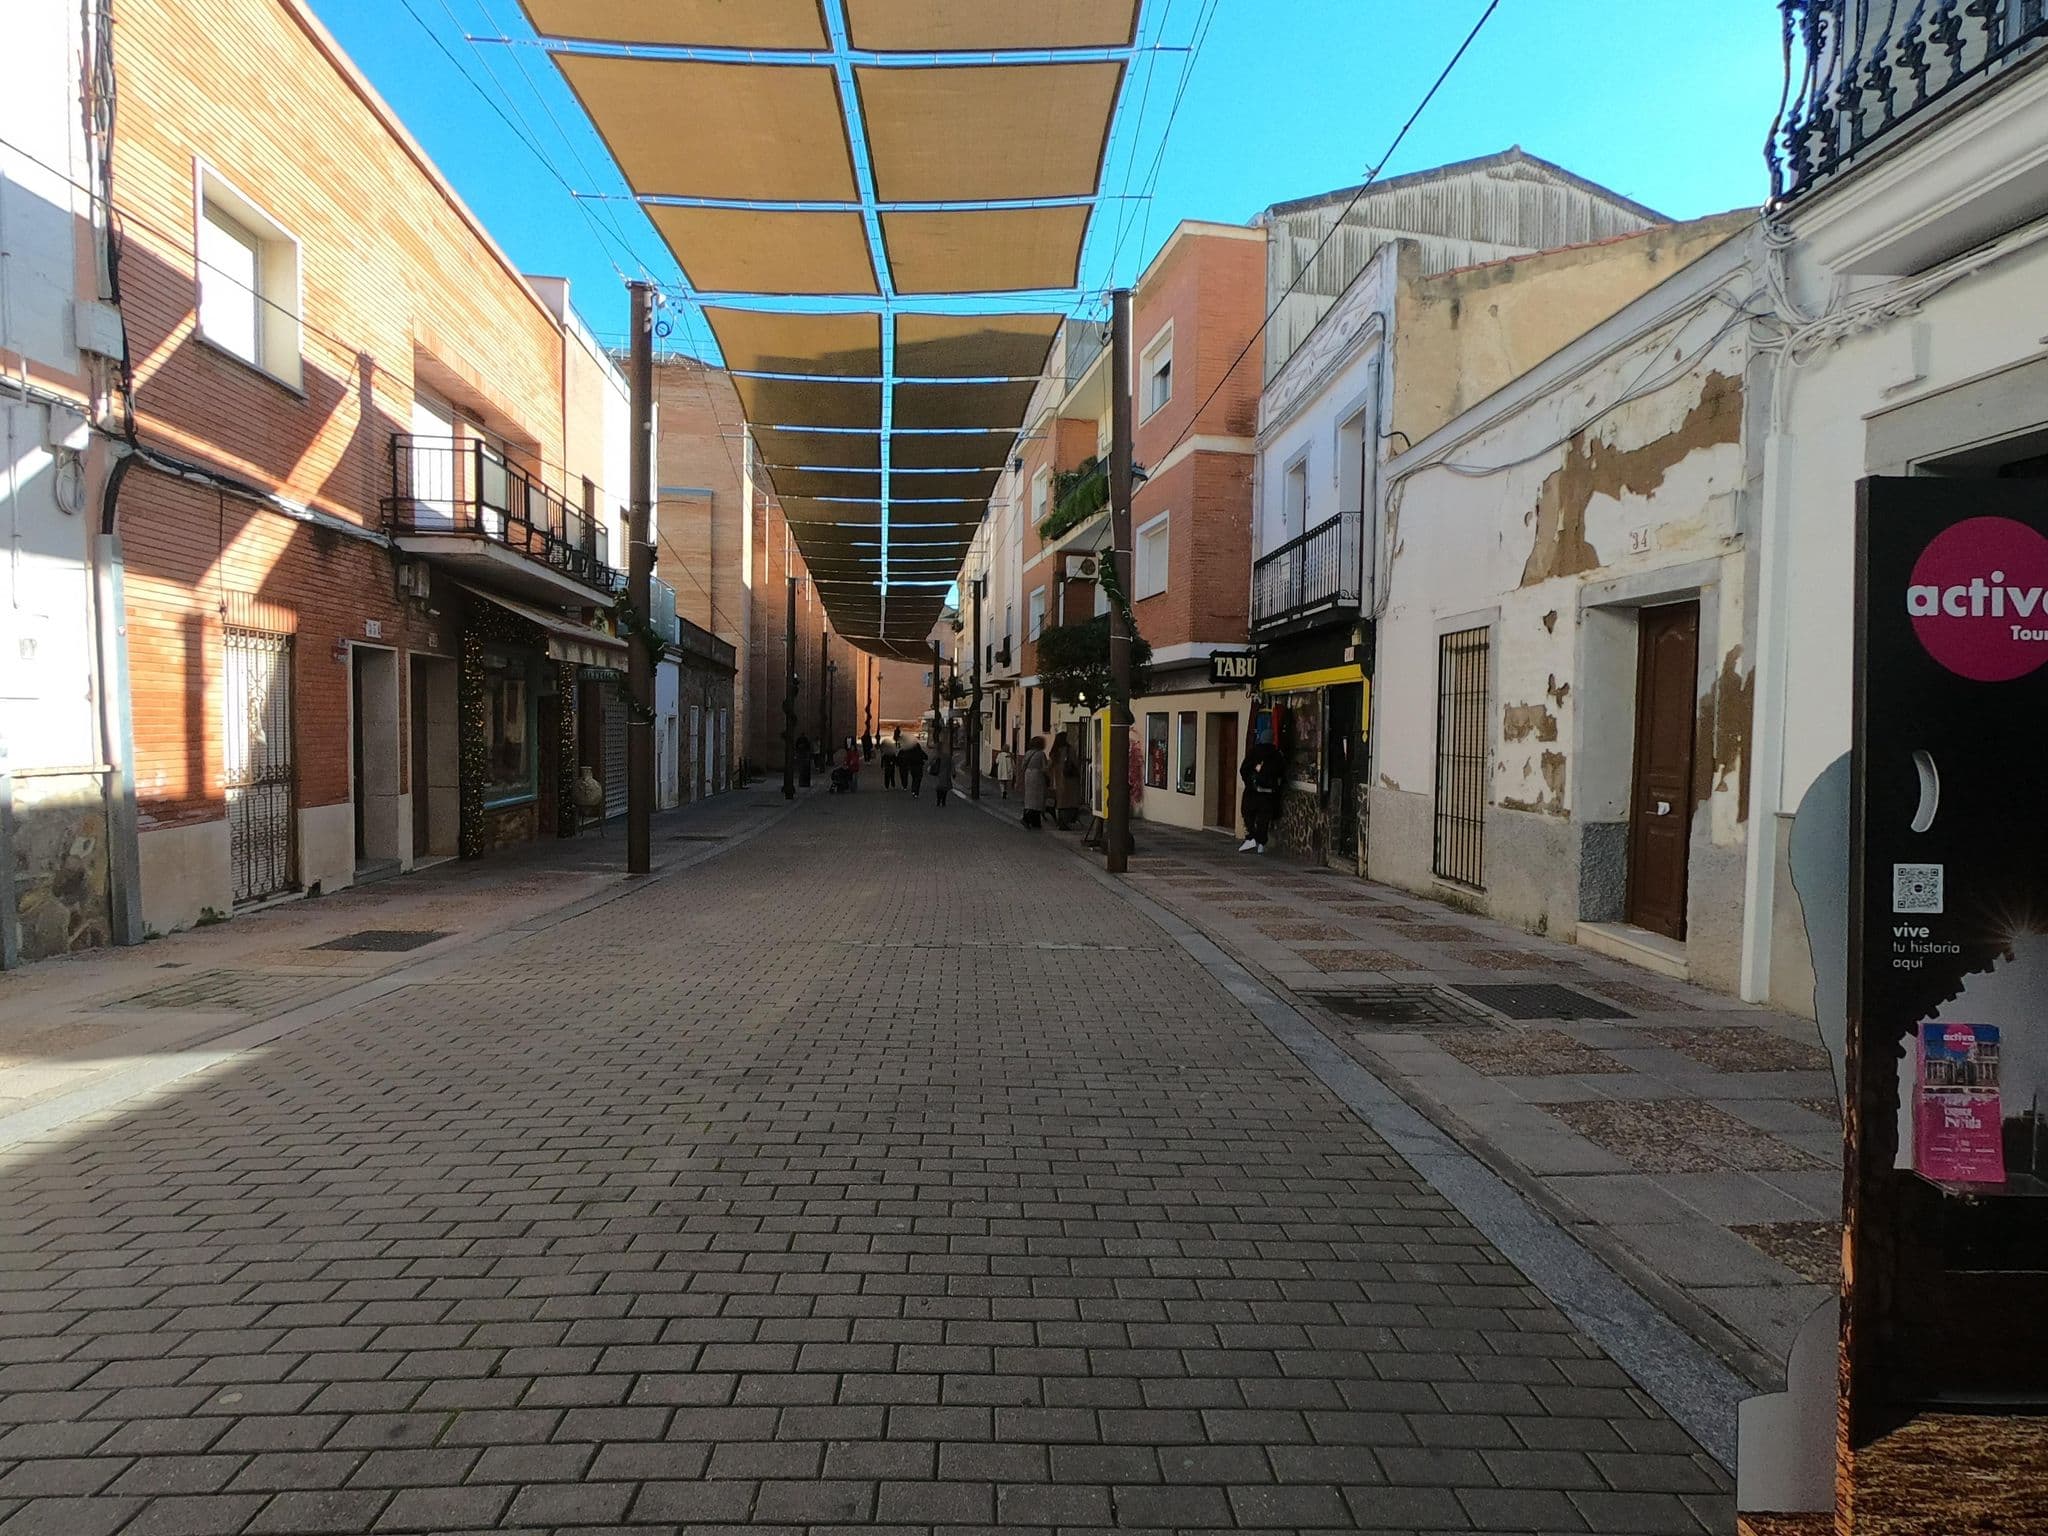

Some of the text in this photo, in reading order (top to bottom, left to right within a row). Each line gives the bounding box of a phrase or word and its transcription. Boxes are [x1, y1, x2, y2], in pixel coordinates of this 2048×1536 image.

[1629, 528, 1648, 550] 34
[1906, 570, 2048, 617] activ
[1214, 654, 1258, 678] TABÚ
[1893, 922, 1930, 938] vive
[1893, 941, 1961, 954] tu historia
